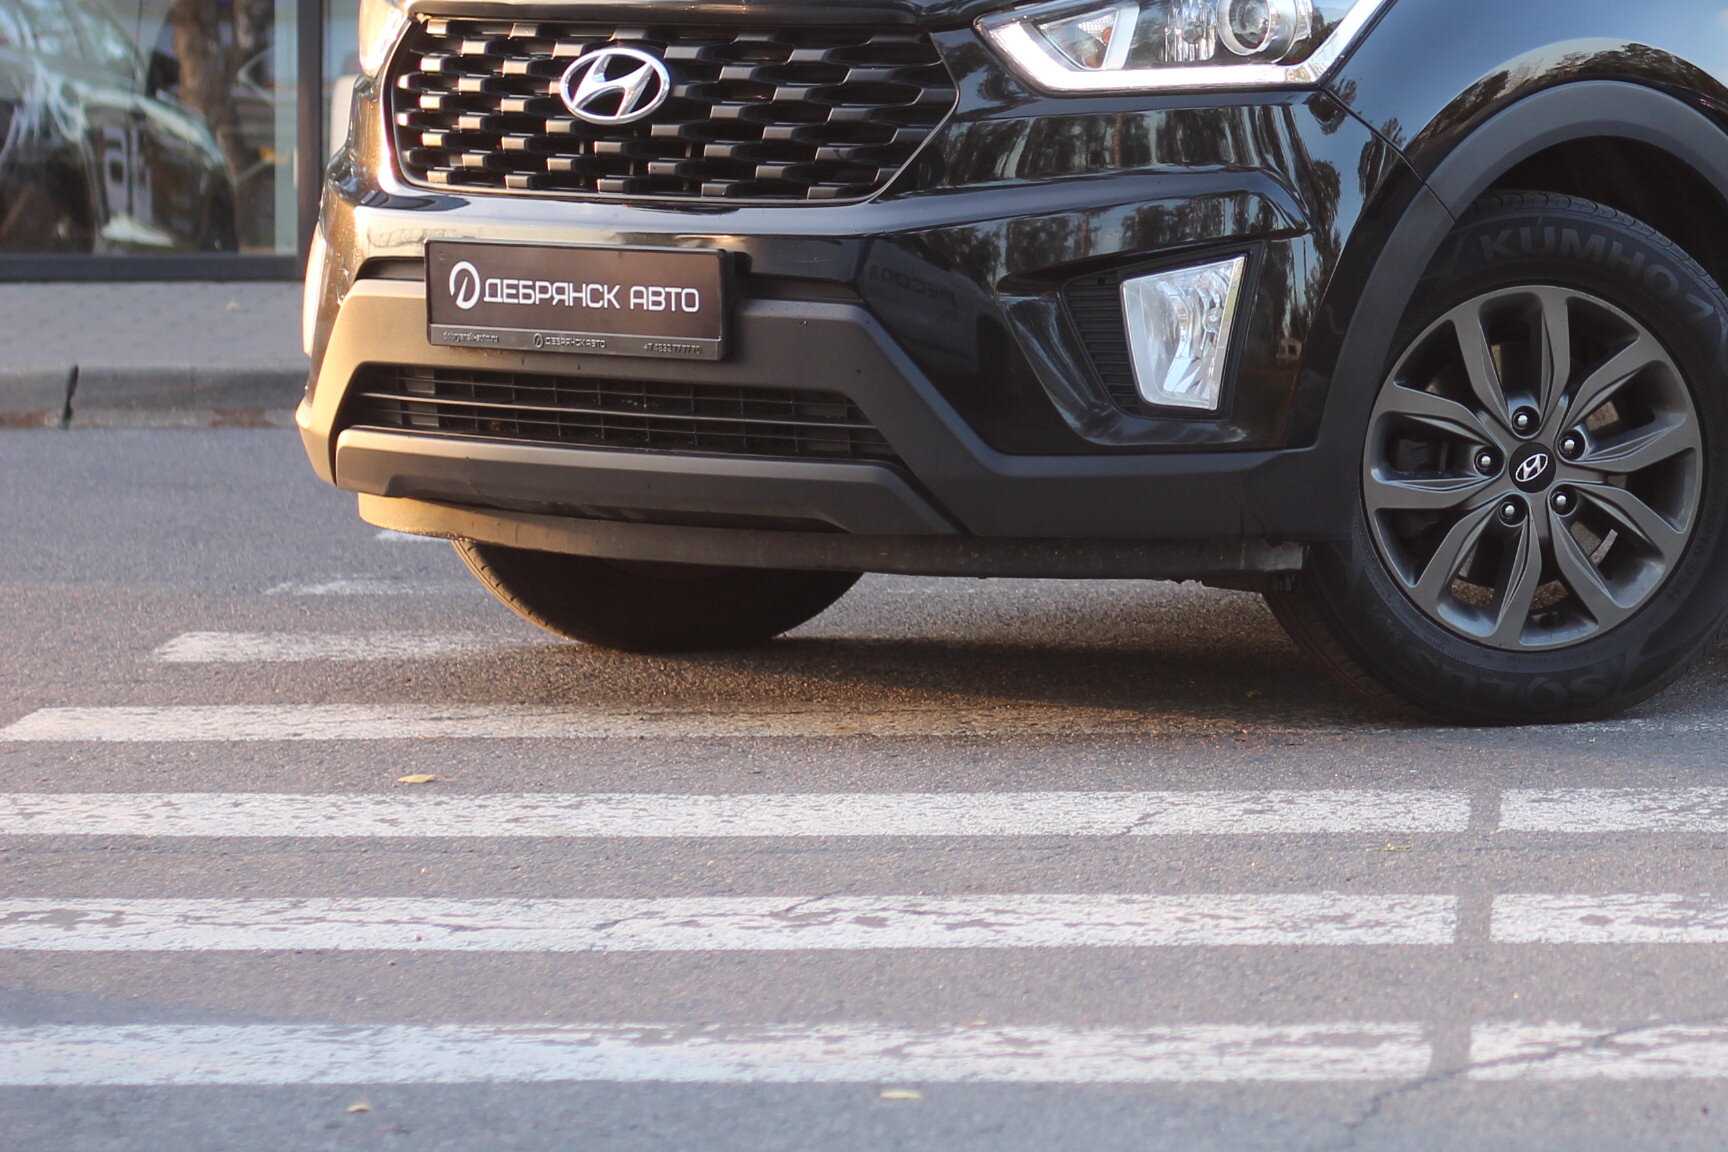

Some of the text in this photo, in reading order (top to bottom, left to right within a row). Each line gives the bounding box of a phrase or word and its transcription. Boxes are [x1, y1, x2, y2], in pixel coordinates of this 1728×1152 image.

[1479, 225, 1684, 297] KUMHO
[482, 277, 701, 314] ДЕБРЯНСК АВТО
